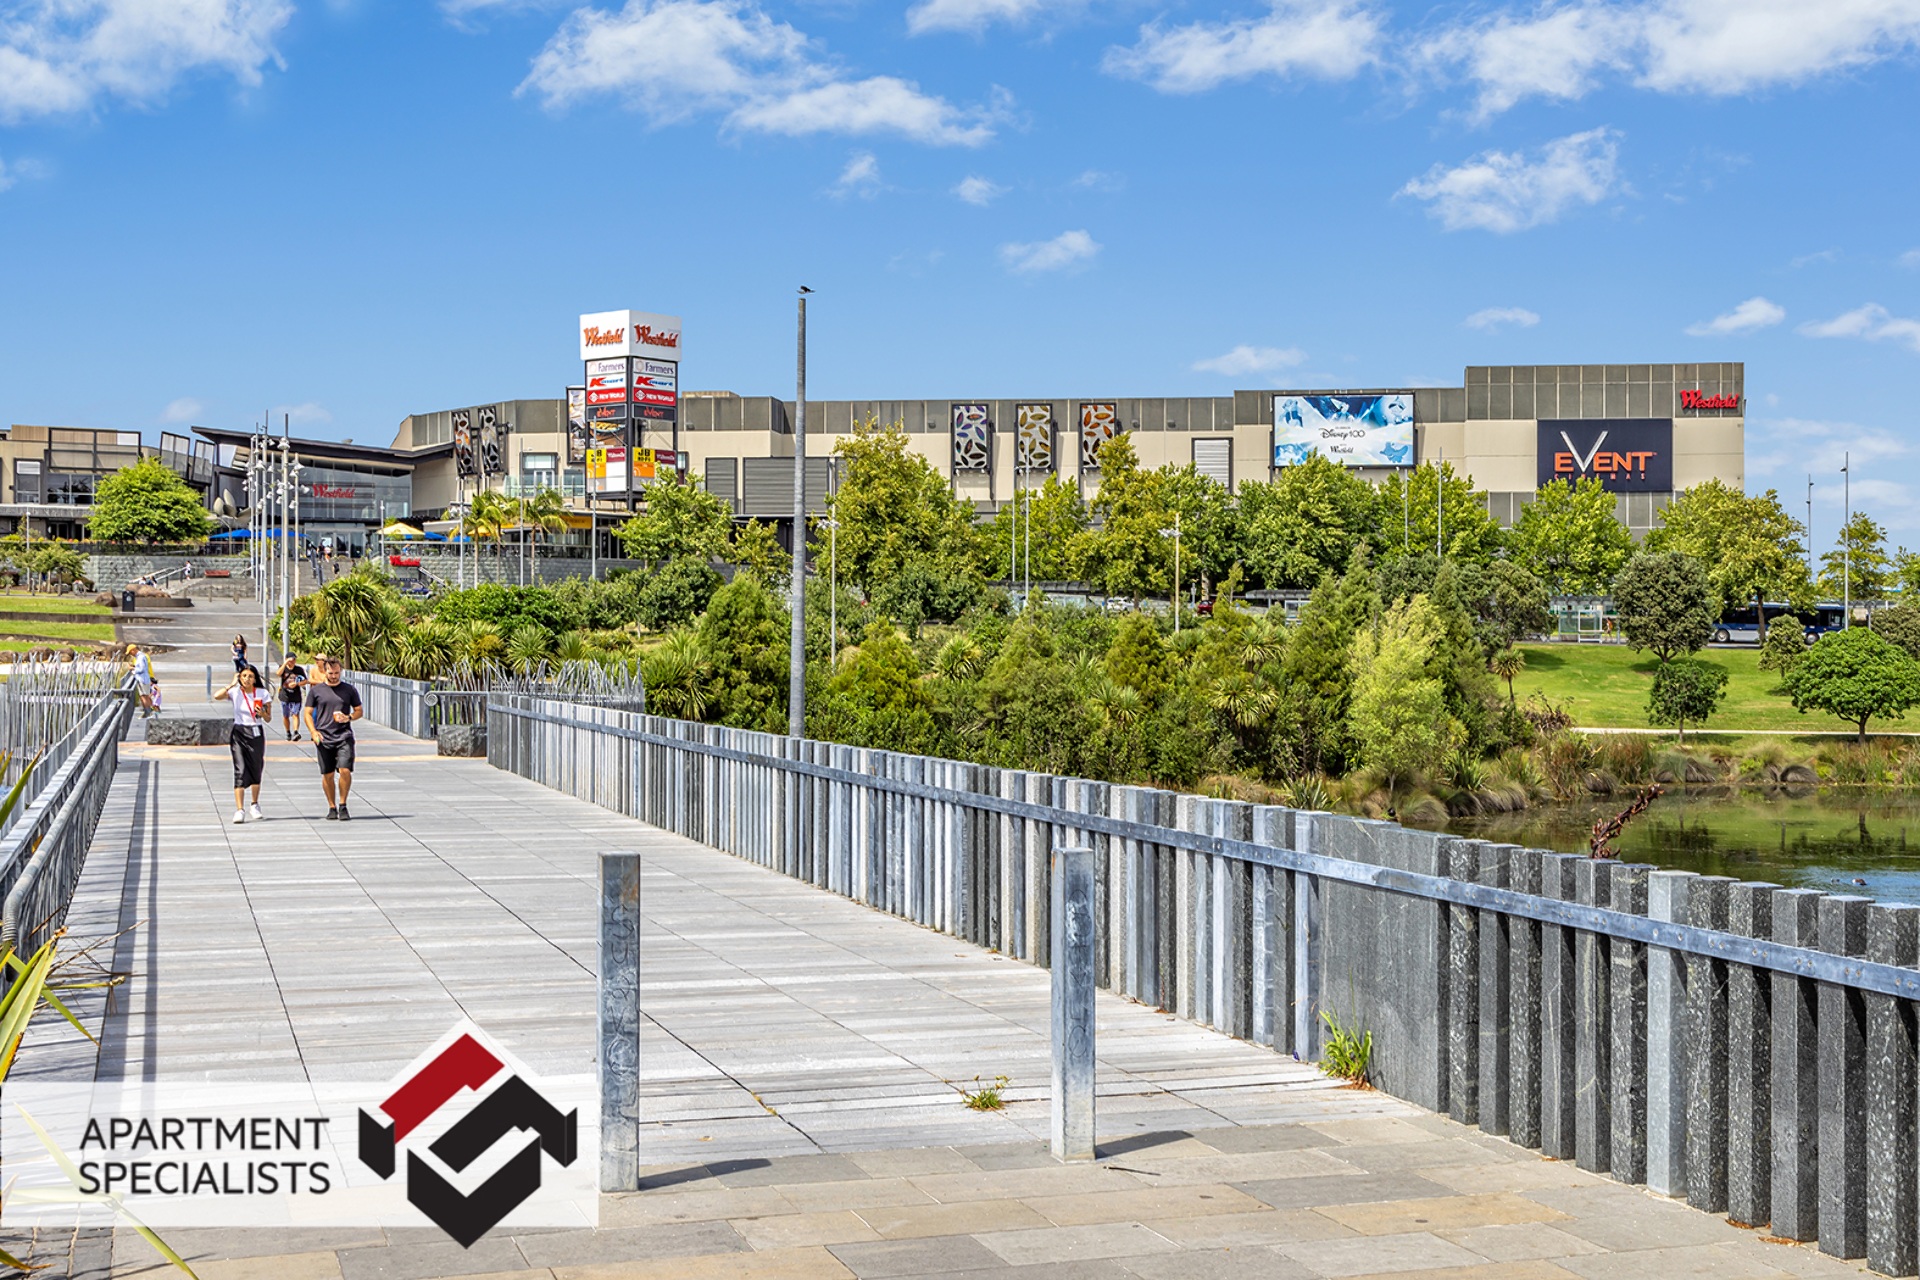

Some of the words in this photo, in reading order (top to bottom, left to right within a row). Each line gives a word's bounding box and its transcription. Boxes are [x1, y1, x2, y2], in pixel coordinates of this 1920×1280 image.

[583, 326, 625, 347] Westfield
[634, 324, 679, 348] Westfield
[598, 362, 625, 372] Farmers
[645, 362, 674, 374] Farmers
[635, 376, 674, 387] Kmart
[657, 394, 674, 402] WORLD
[1679, 389, 1740, 410] Westfield
[1318, 427, 1348, 440] Disney
[1349, 429, 1366, 438] 100
[637, 448, 651, 457] JB
[1553, 430, 1655, 472] EVENT
[312, 483, 356, 499] Westfield
